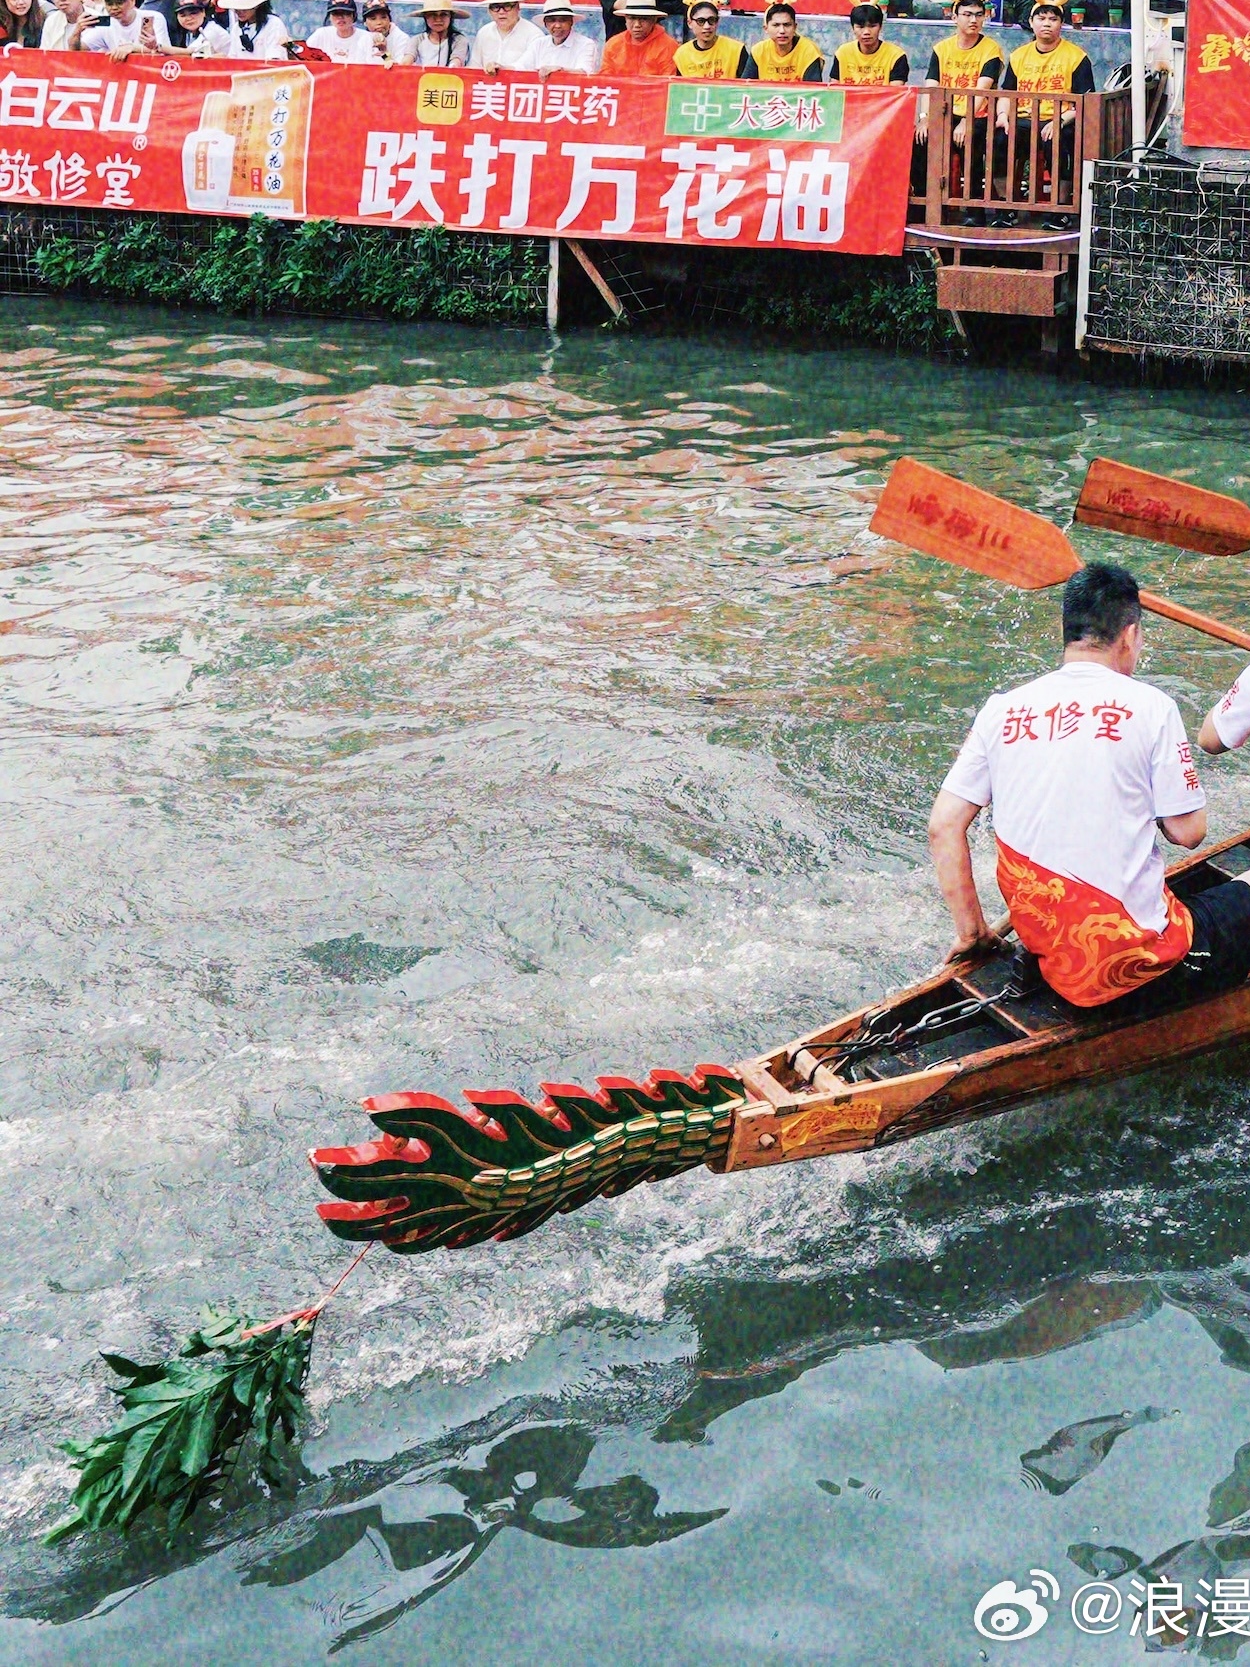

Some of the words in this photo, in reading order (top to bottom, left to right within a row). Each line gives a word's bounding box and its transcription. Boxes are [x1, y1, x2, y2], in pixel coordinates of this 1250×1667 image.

[0, 70, 157, 136] 白云山
[421, 88, 459, 110] 美团
[470, 81, 619, 127] 美团买药
[730, 94, 825, 132] 大参林
[263, 87, 292, 192] 跌打万花油
[0, 149, 142, 207] 敬修堂
[358, 131, 850, 244] 跌打万花油
[1001, 698, 1134, 744] 敬修堂
